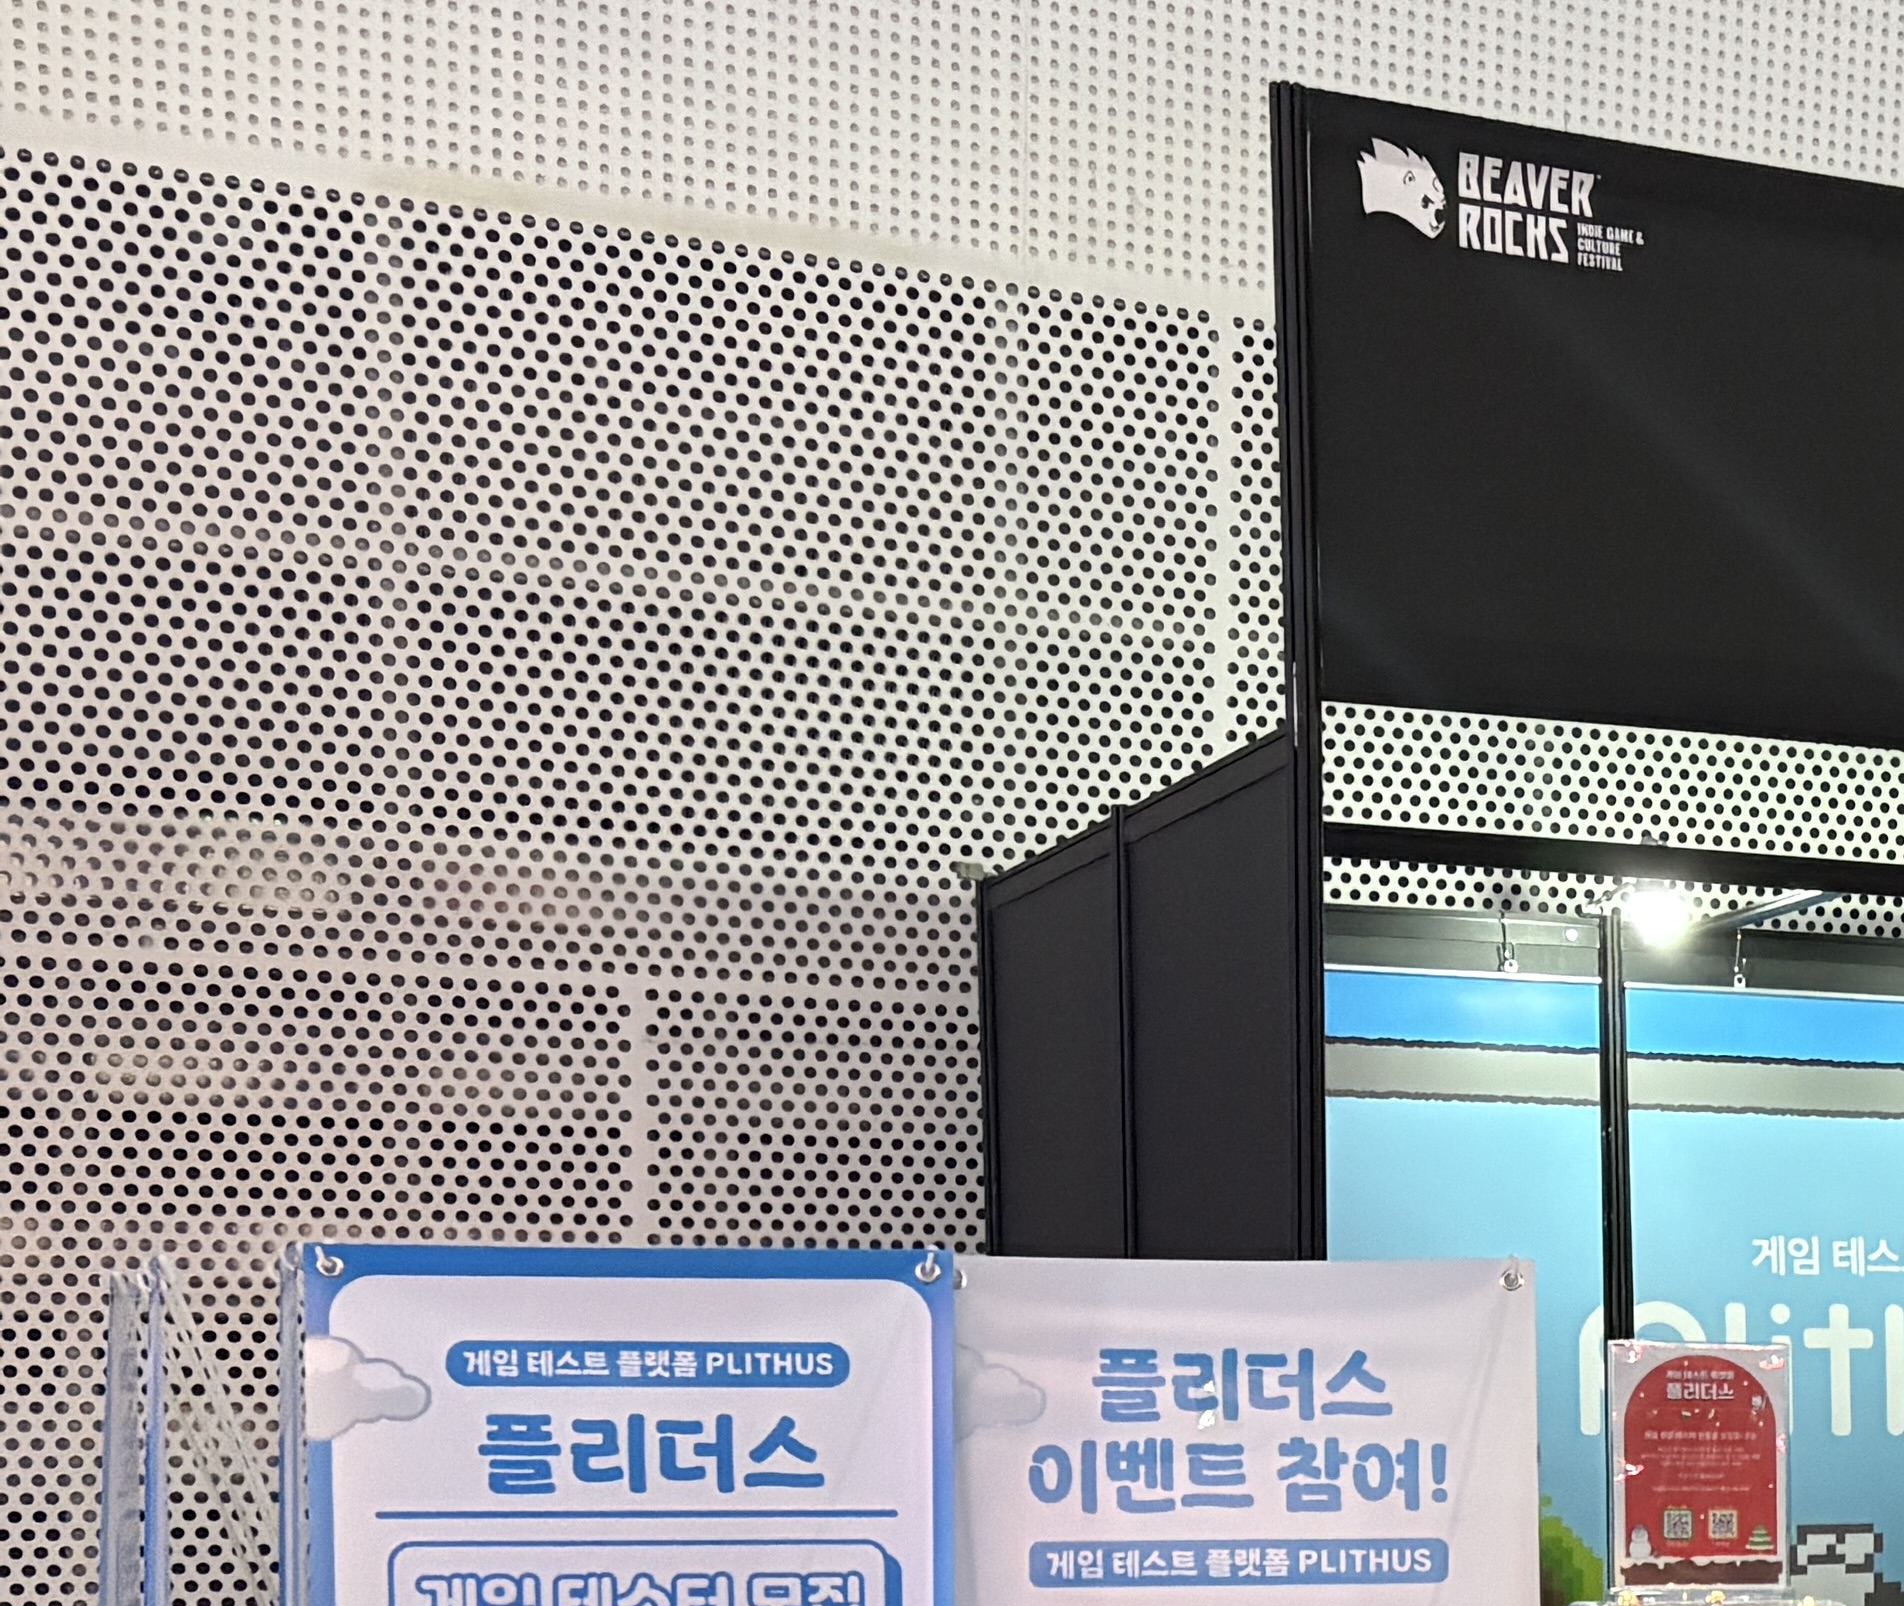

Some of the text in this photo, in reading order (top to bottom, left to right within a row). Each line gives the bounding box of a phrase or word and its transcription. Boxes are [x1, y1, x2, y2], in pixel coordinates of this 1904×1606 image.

[1458, 152, 1594, 217] BEAVER
[1458, 203, 1568, 264] ROCKS
[1577, 222, 1603, 238] INDIE
[1607, 226, 1636, 244] GAME
[1578, 239, 1620, 256] CULTURE
[1578, 254, 1622, 272] FESTIVAL
[1751, 1236, 1821, 1275] 게임
[463, 1350, 833, 1378] 게임 테스트 플랫폼 PLITHUS
[1092, 1348, 1393, 1423] 플리더스
[478, 1413, 824, 1494] 플리더스
[1028, 1437, 1448, 1514] 이벤트 참여!
[1046, 1550, 1432, 1578] 게임 테스트 플랫폼 PLITHUS
